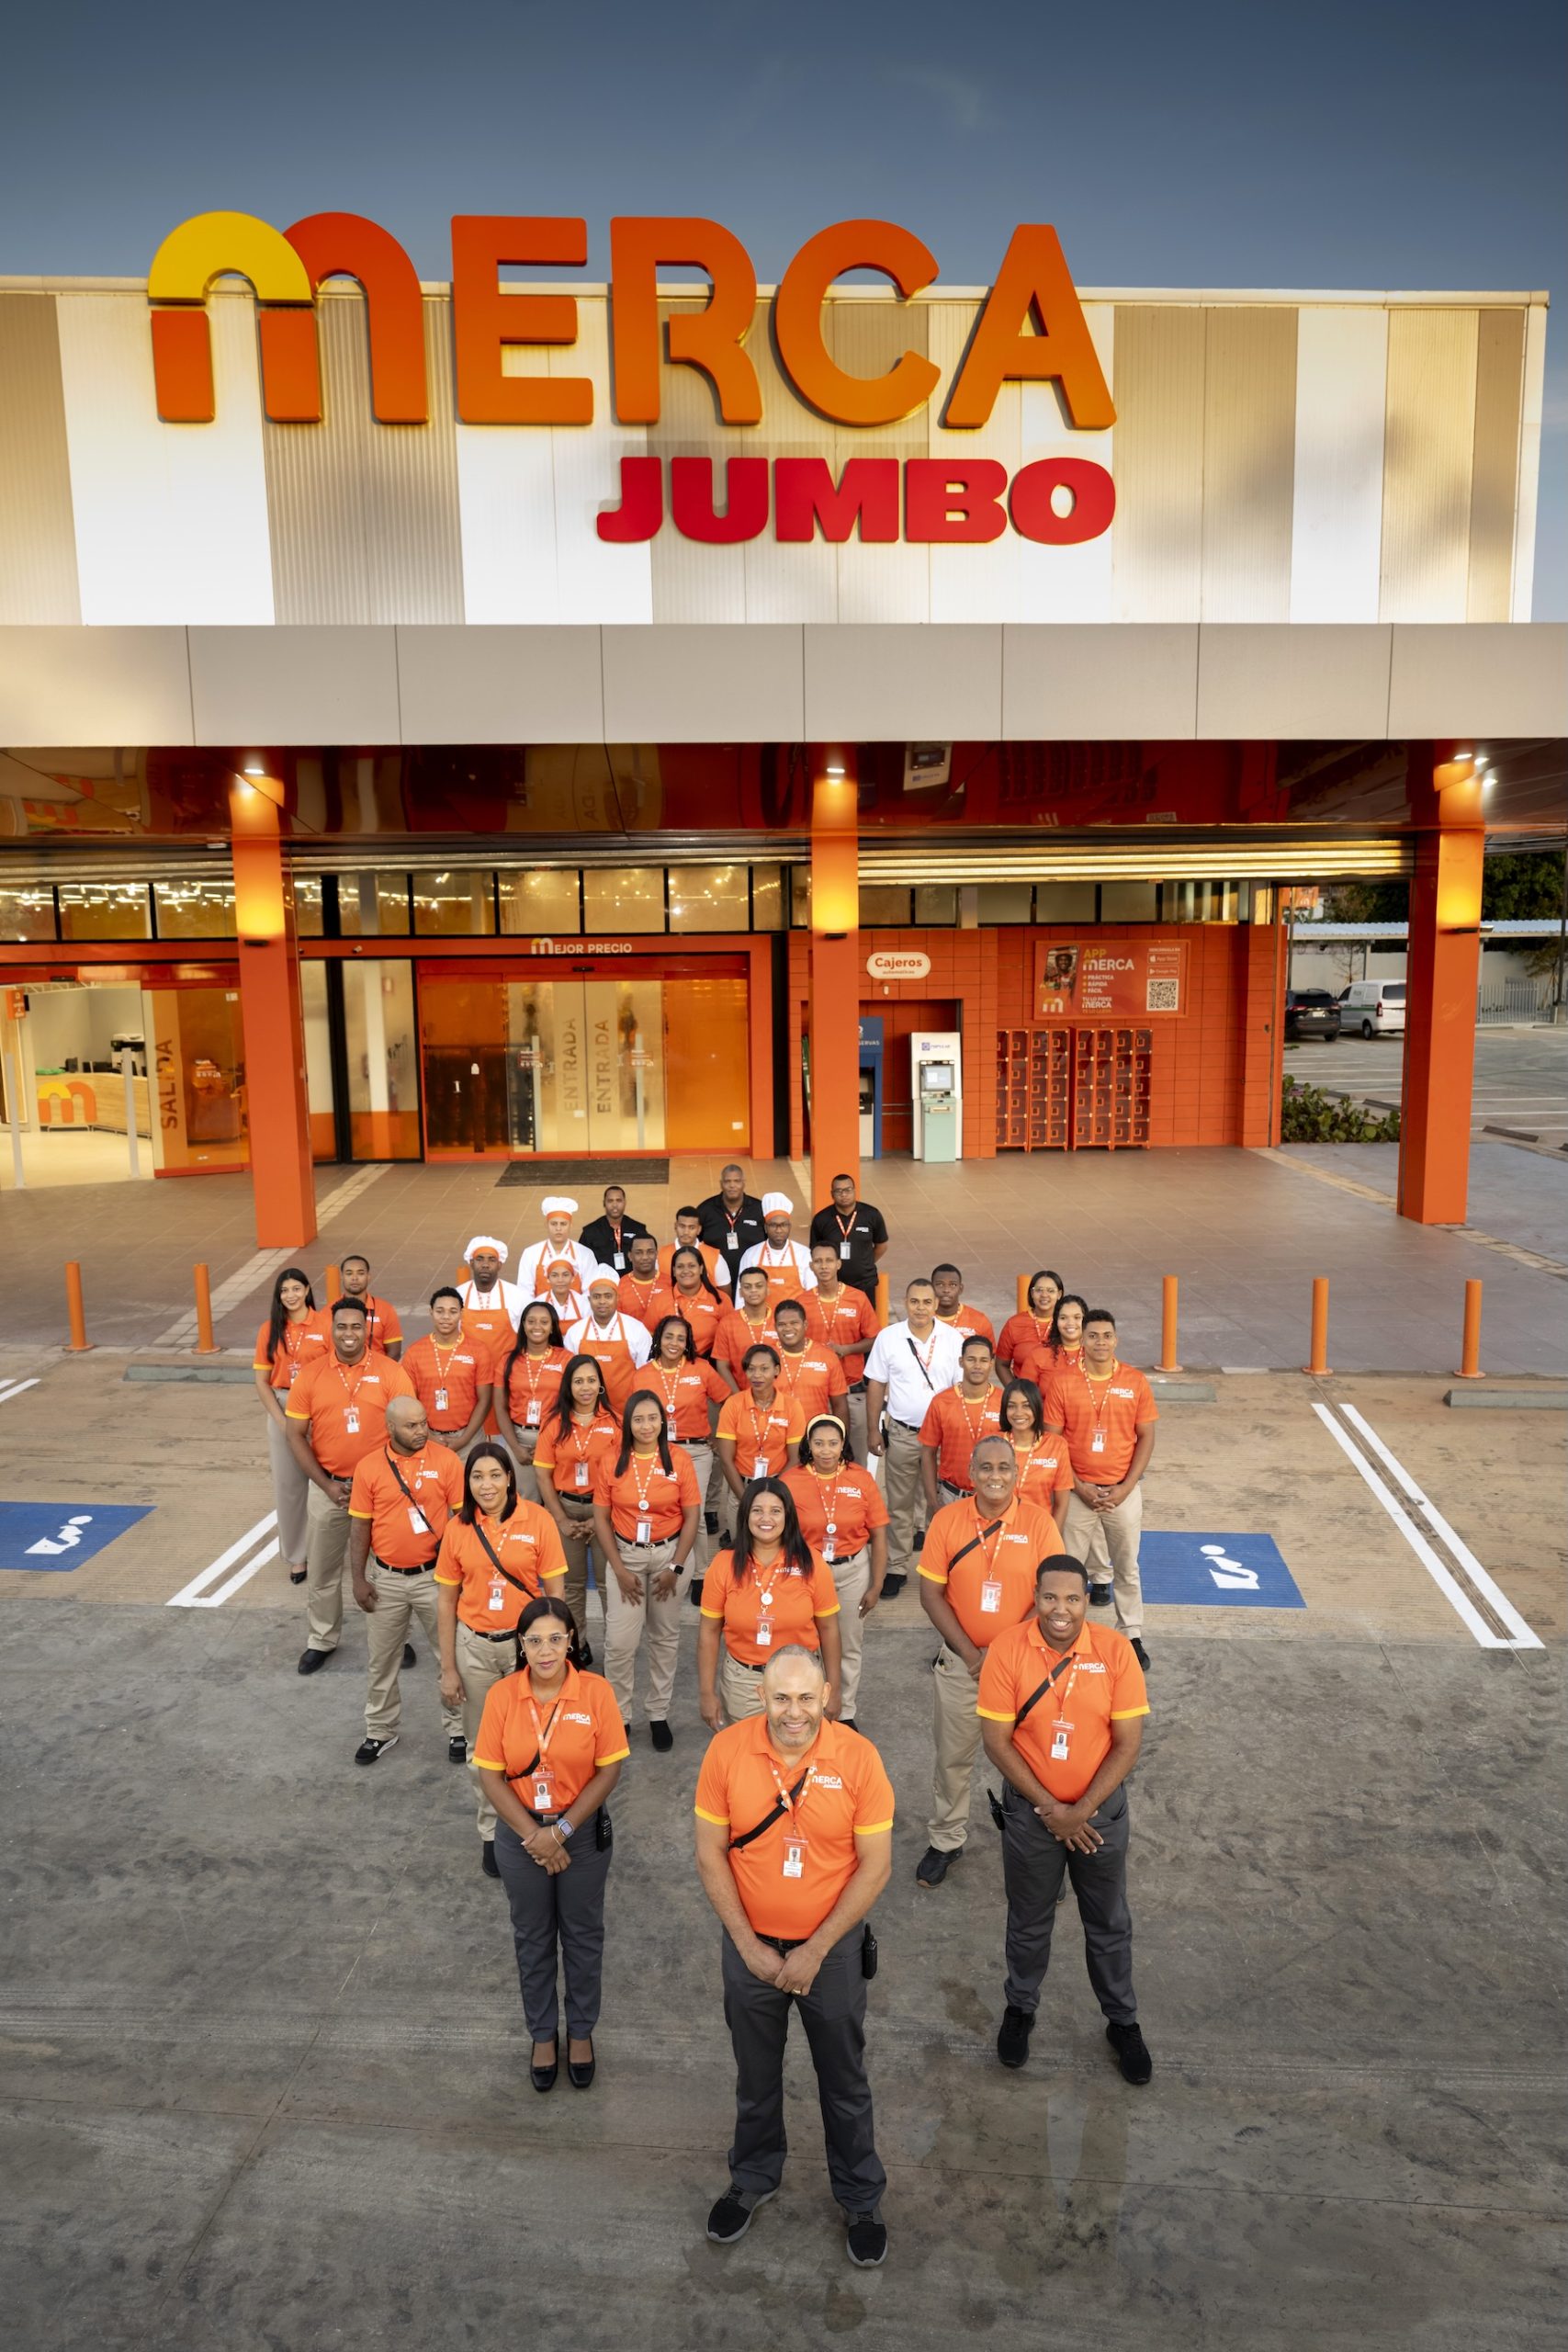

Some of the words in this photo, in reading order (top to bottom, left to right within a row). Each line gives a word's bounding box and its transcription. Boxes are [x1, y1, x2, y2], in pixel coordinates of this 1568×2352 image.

[597, 457, 1116, 545] JUMBO
[588, 944, 633, 954] PRECIO
[874, 956, 923, 969] Cajeros
[1084, 949, 1107, 958] APP
[562, 1017, 578, 1113] ENTRADA
[595, 1020, 612, 1114] ENTRADA
